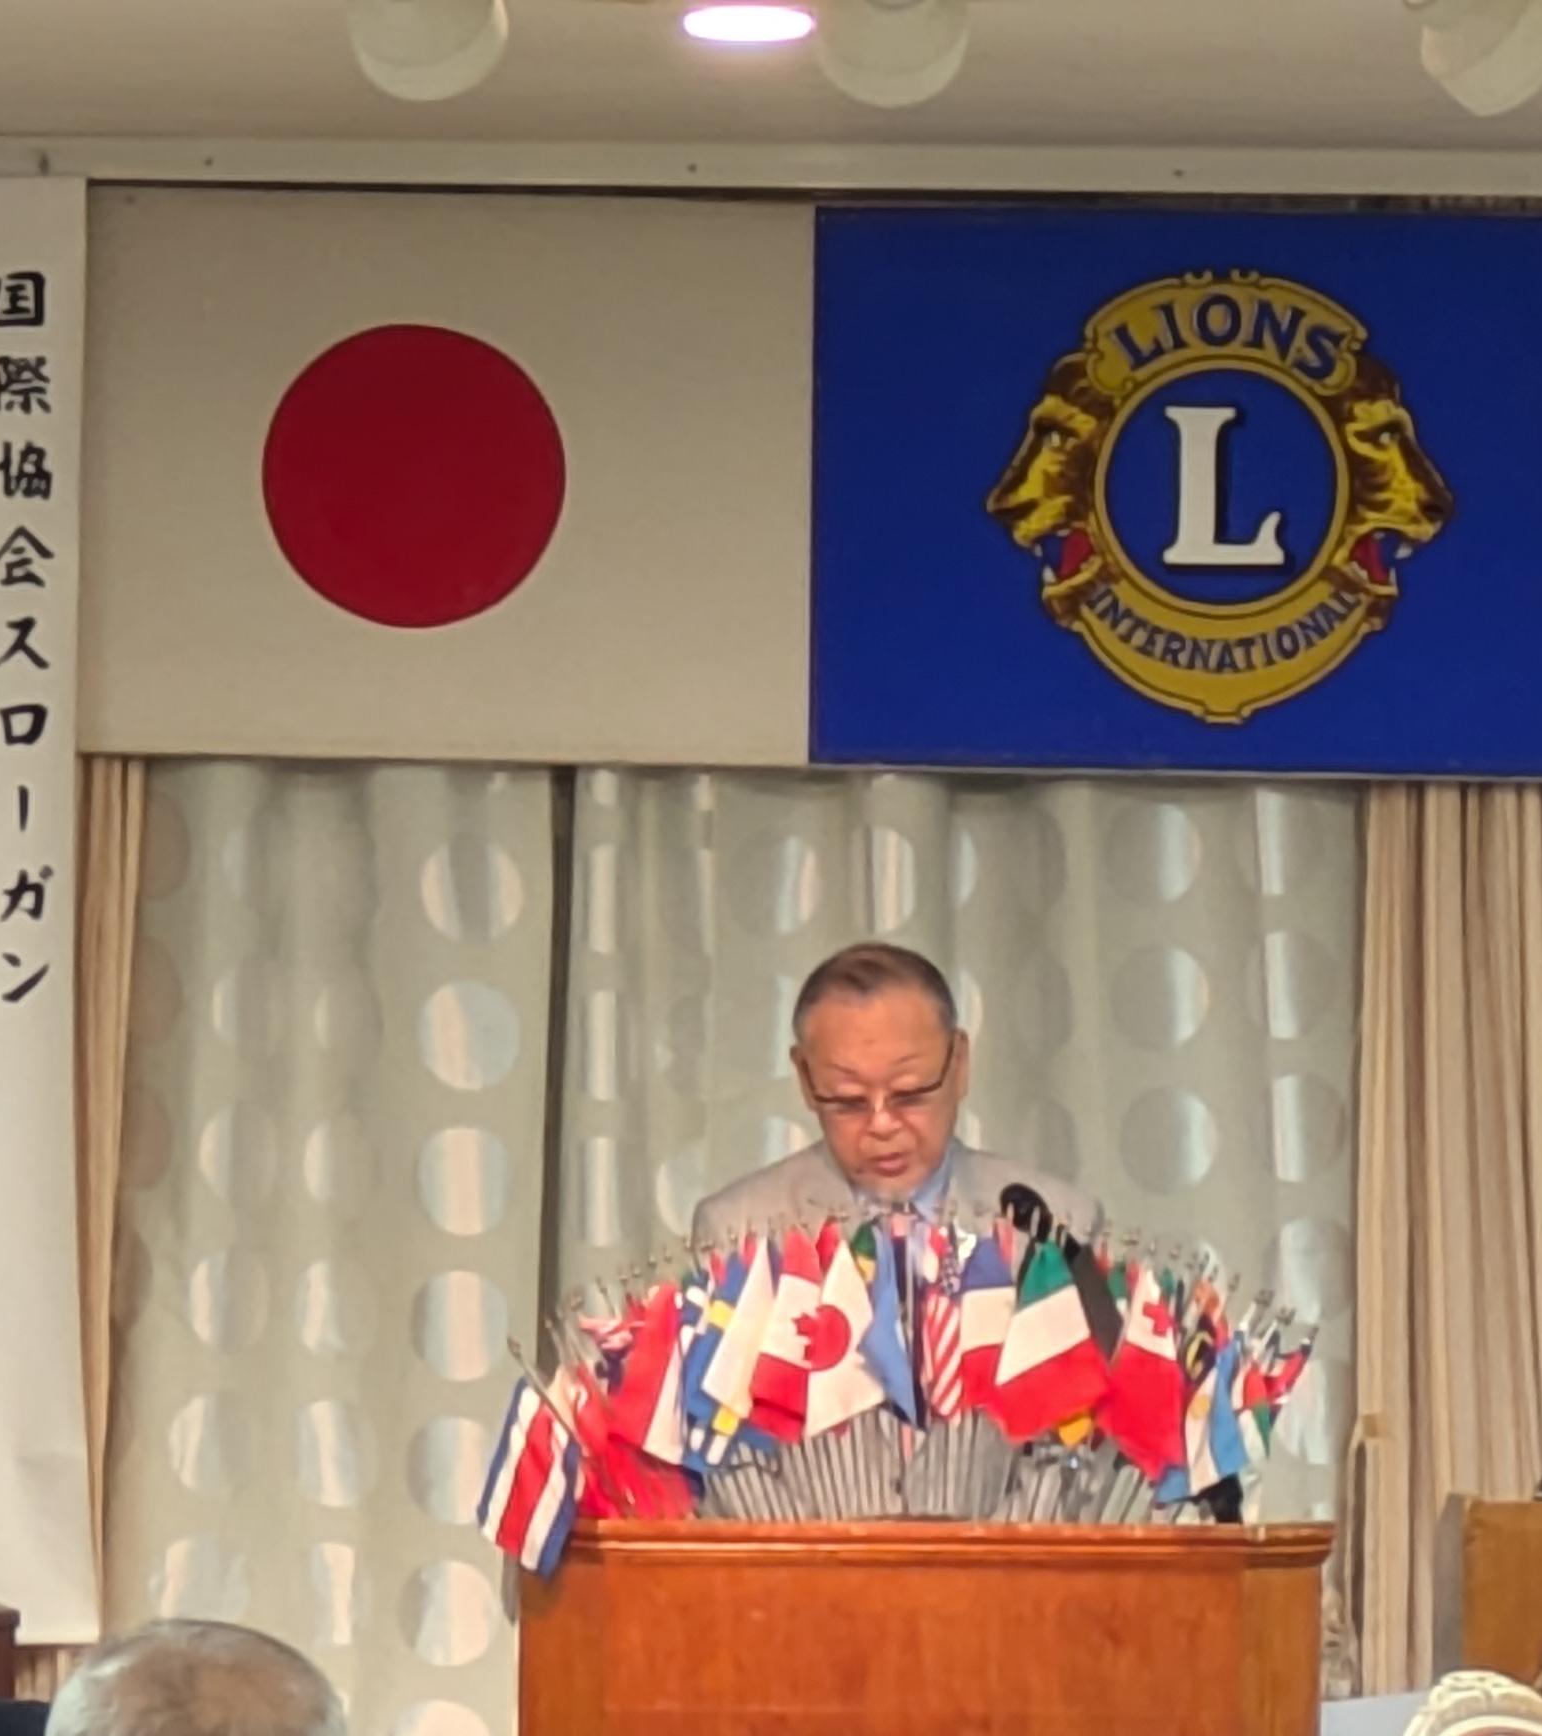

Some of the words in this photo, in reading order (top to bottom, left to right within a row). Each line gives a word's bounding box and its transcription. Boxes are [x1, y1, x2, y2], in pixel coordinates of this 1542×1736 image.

[1107, 293, 1350, 382] LIONS
[1162, 406, 1285, 566] L
[1091, 583, 1364, 676] INTERNATIONAL
